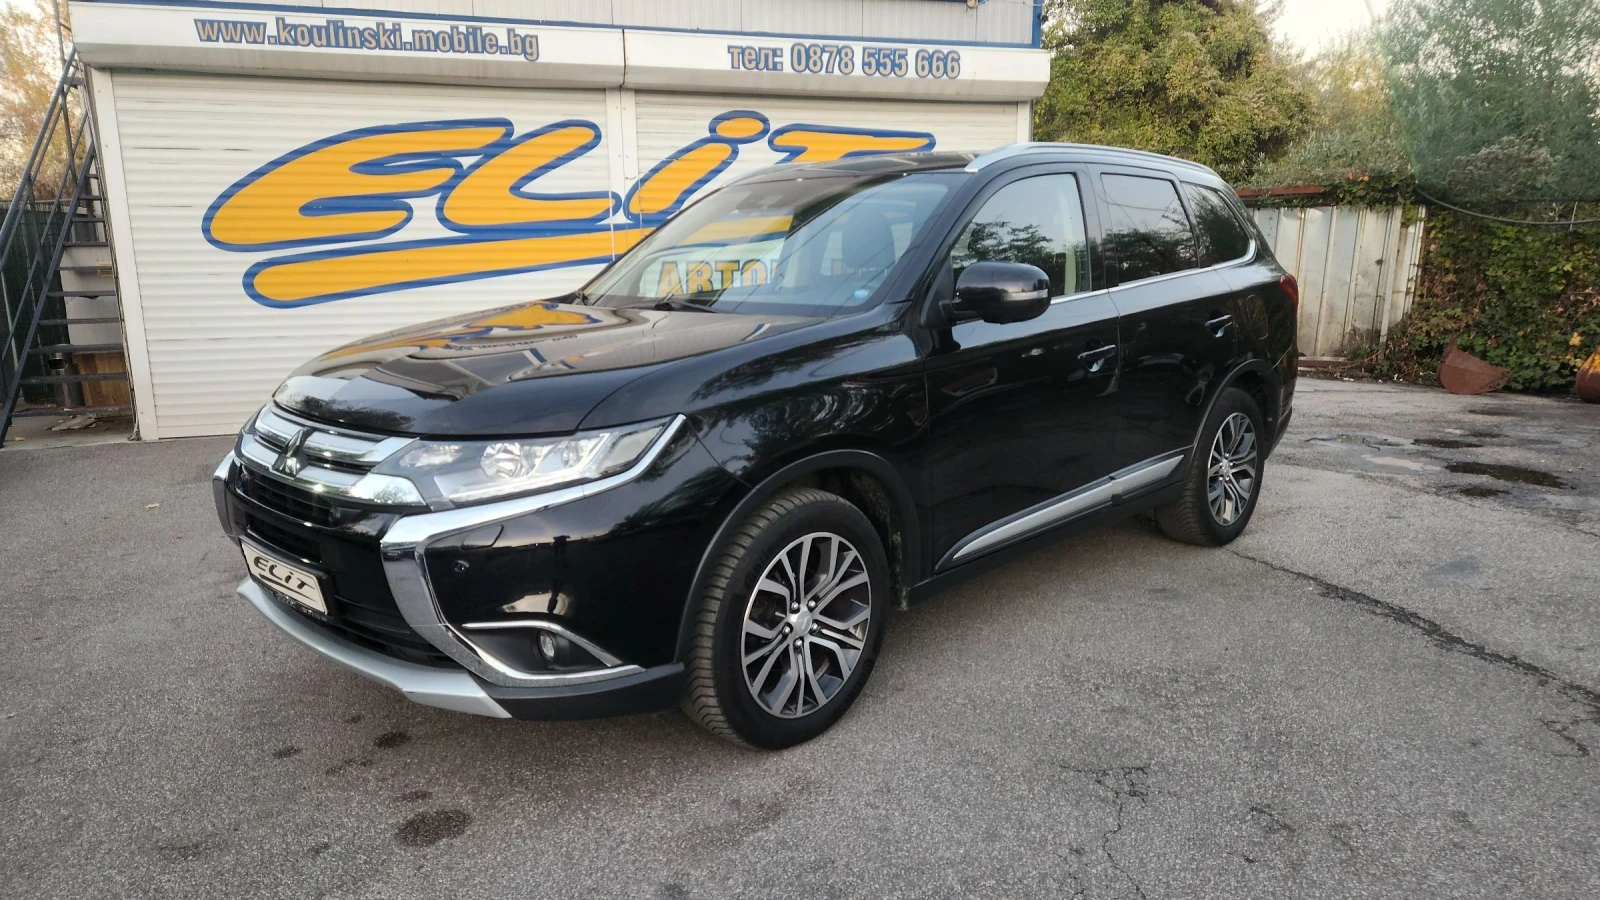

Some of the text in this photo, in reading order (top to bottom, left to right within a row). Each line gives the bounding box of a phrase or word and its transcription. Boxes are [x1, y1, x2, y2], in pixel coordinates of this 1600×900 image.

[194, 17, 540, 62] www.koulinski.mobile.bg
[727, 42, 961, 79] тел: 0878 555 666
